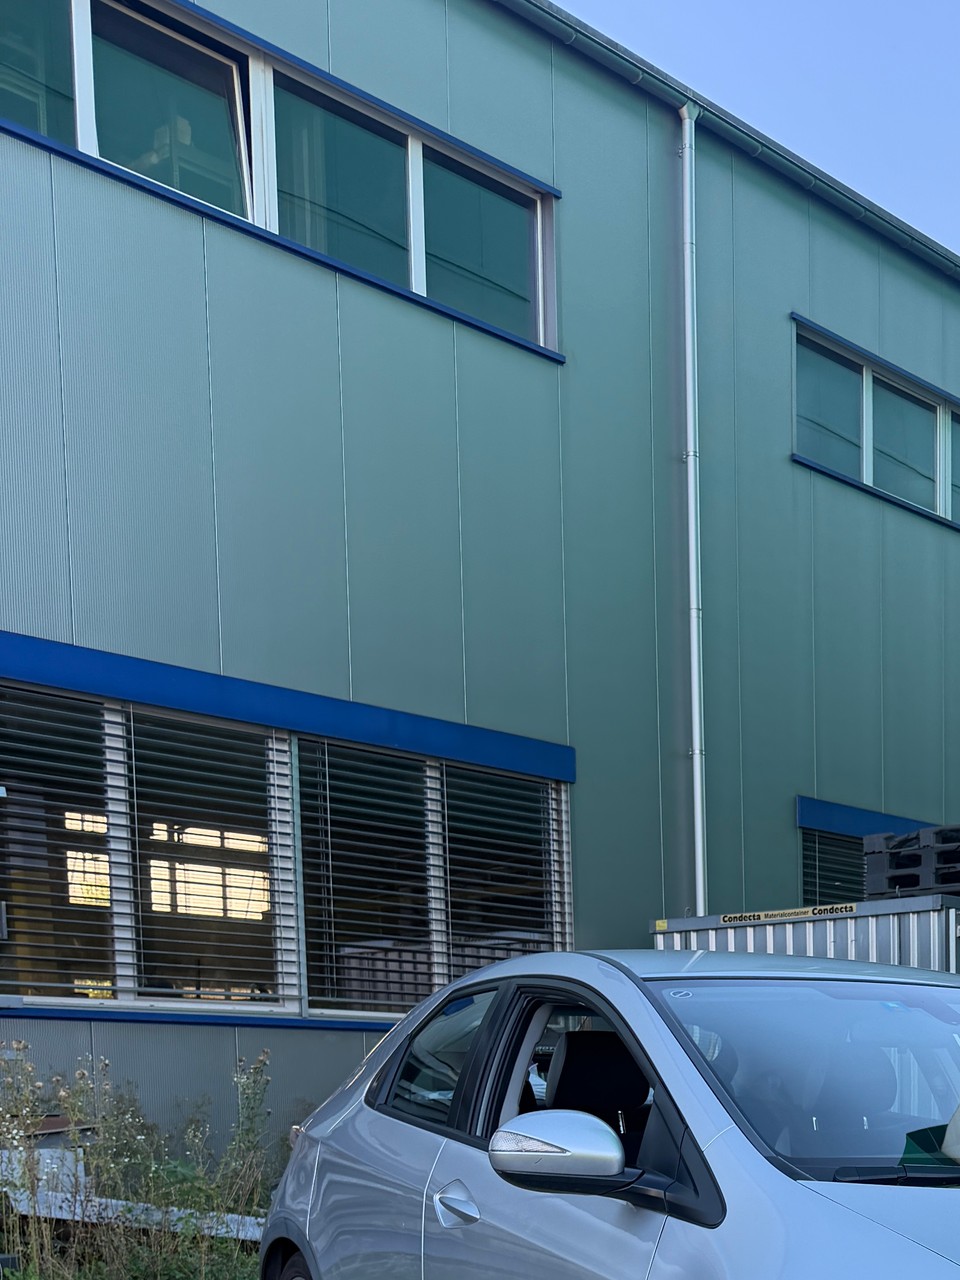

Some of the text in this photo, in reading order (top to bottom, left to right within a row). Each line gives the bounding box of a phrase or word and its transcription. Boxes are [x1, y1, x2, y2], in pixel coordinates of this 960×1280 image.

[722, 904, 854, 923] Condecta Materialcontainer Condecta
